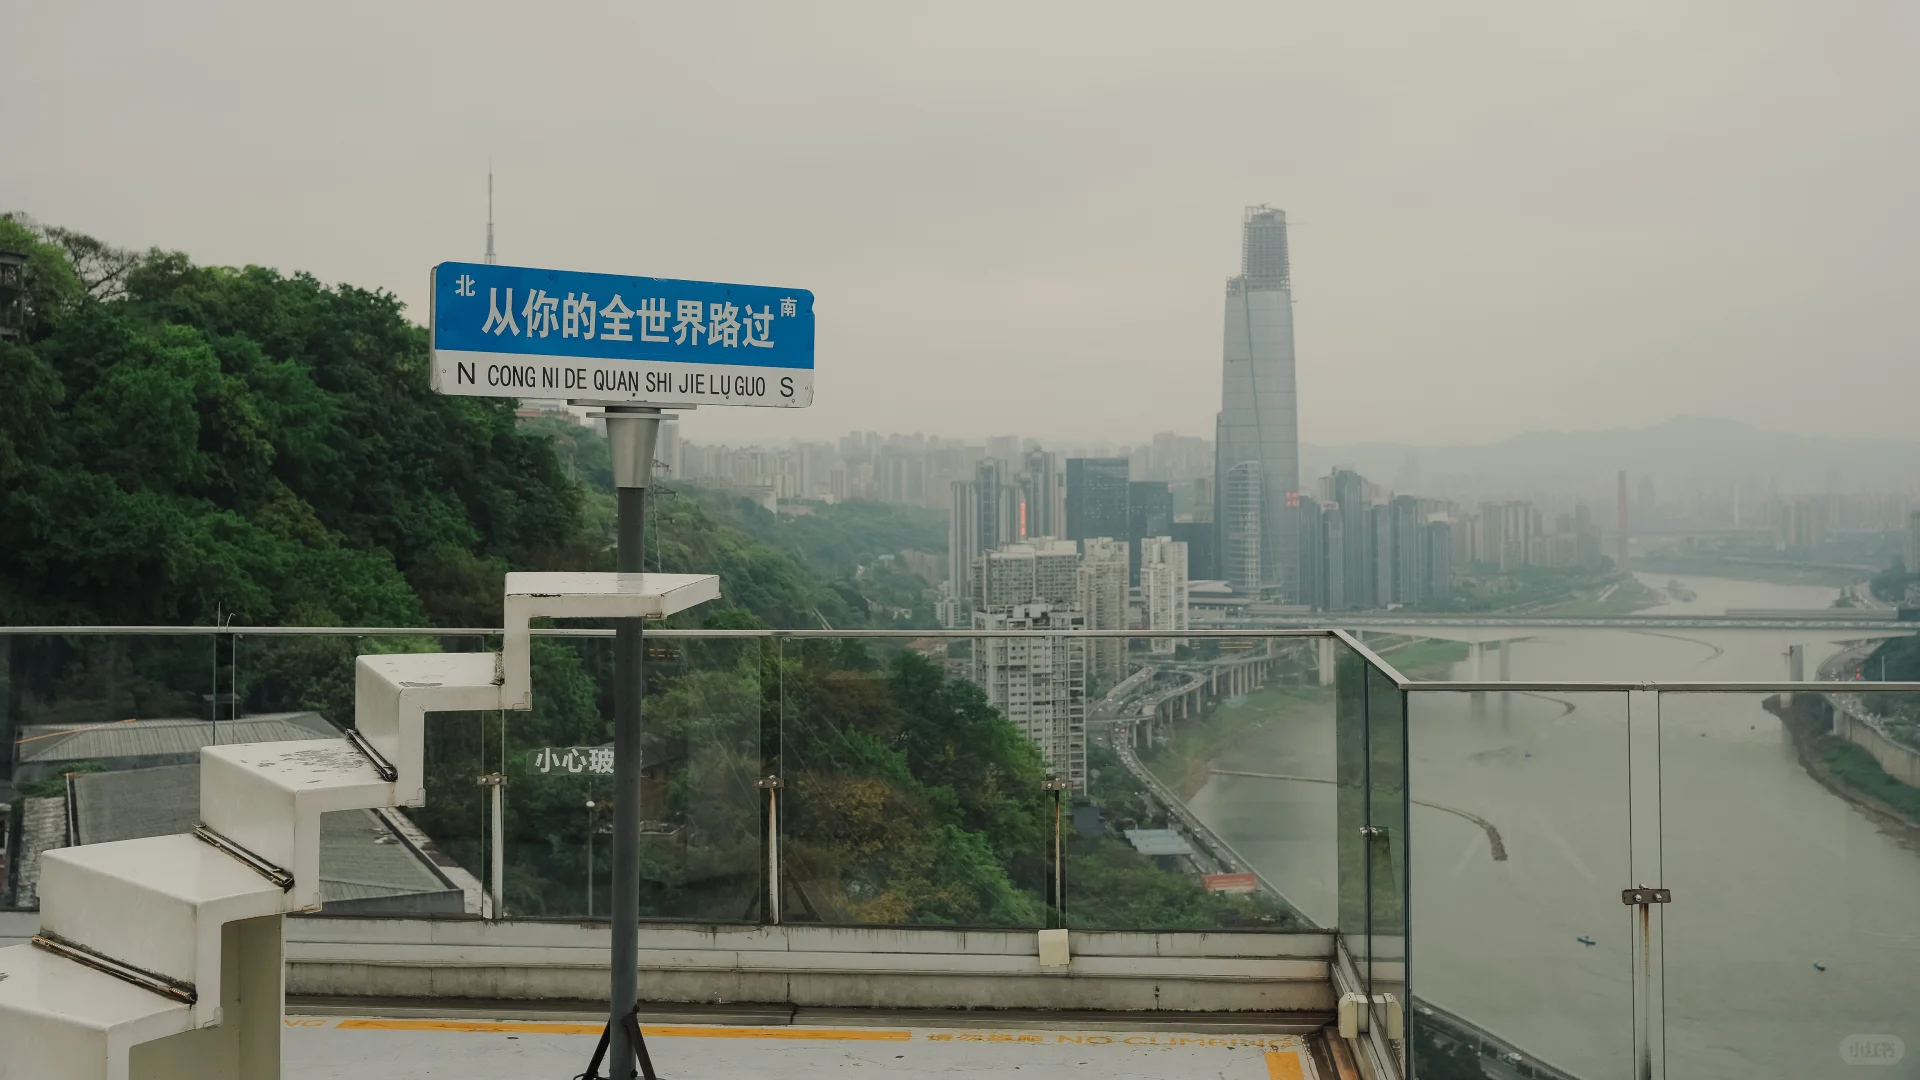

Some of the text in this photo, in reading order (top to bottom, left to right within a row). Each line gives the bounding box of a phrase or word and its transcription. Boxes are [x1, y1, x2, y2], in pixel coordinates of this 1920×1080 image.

[455, 274, 798, 349] 北 从你的全世界路过 南
[457, 361, 795, 398] N CONG NI DE QUAN SHI JIE LU GUO S
[1057, 1034, 1293, 1047] NO CLIMBING
